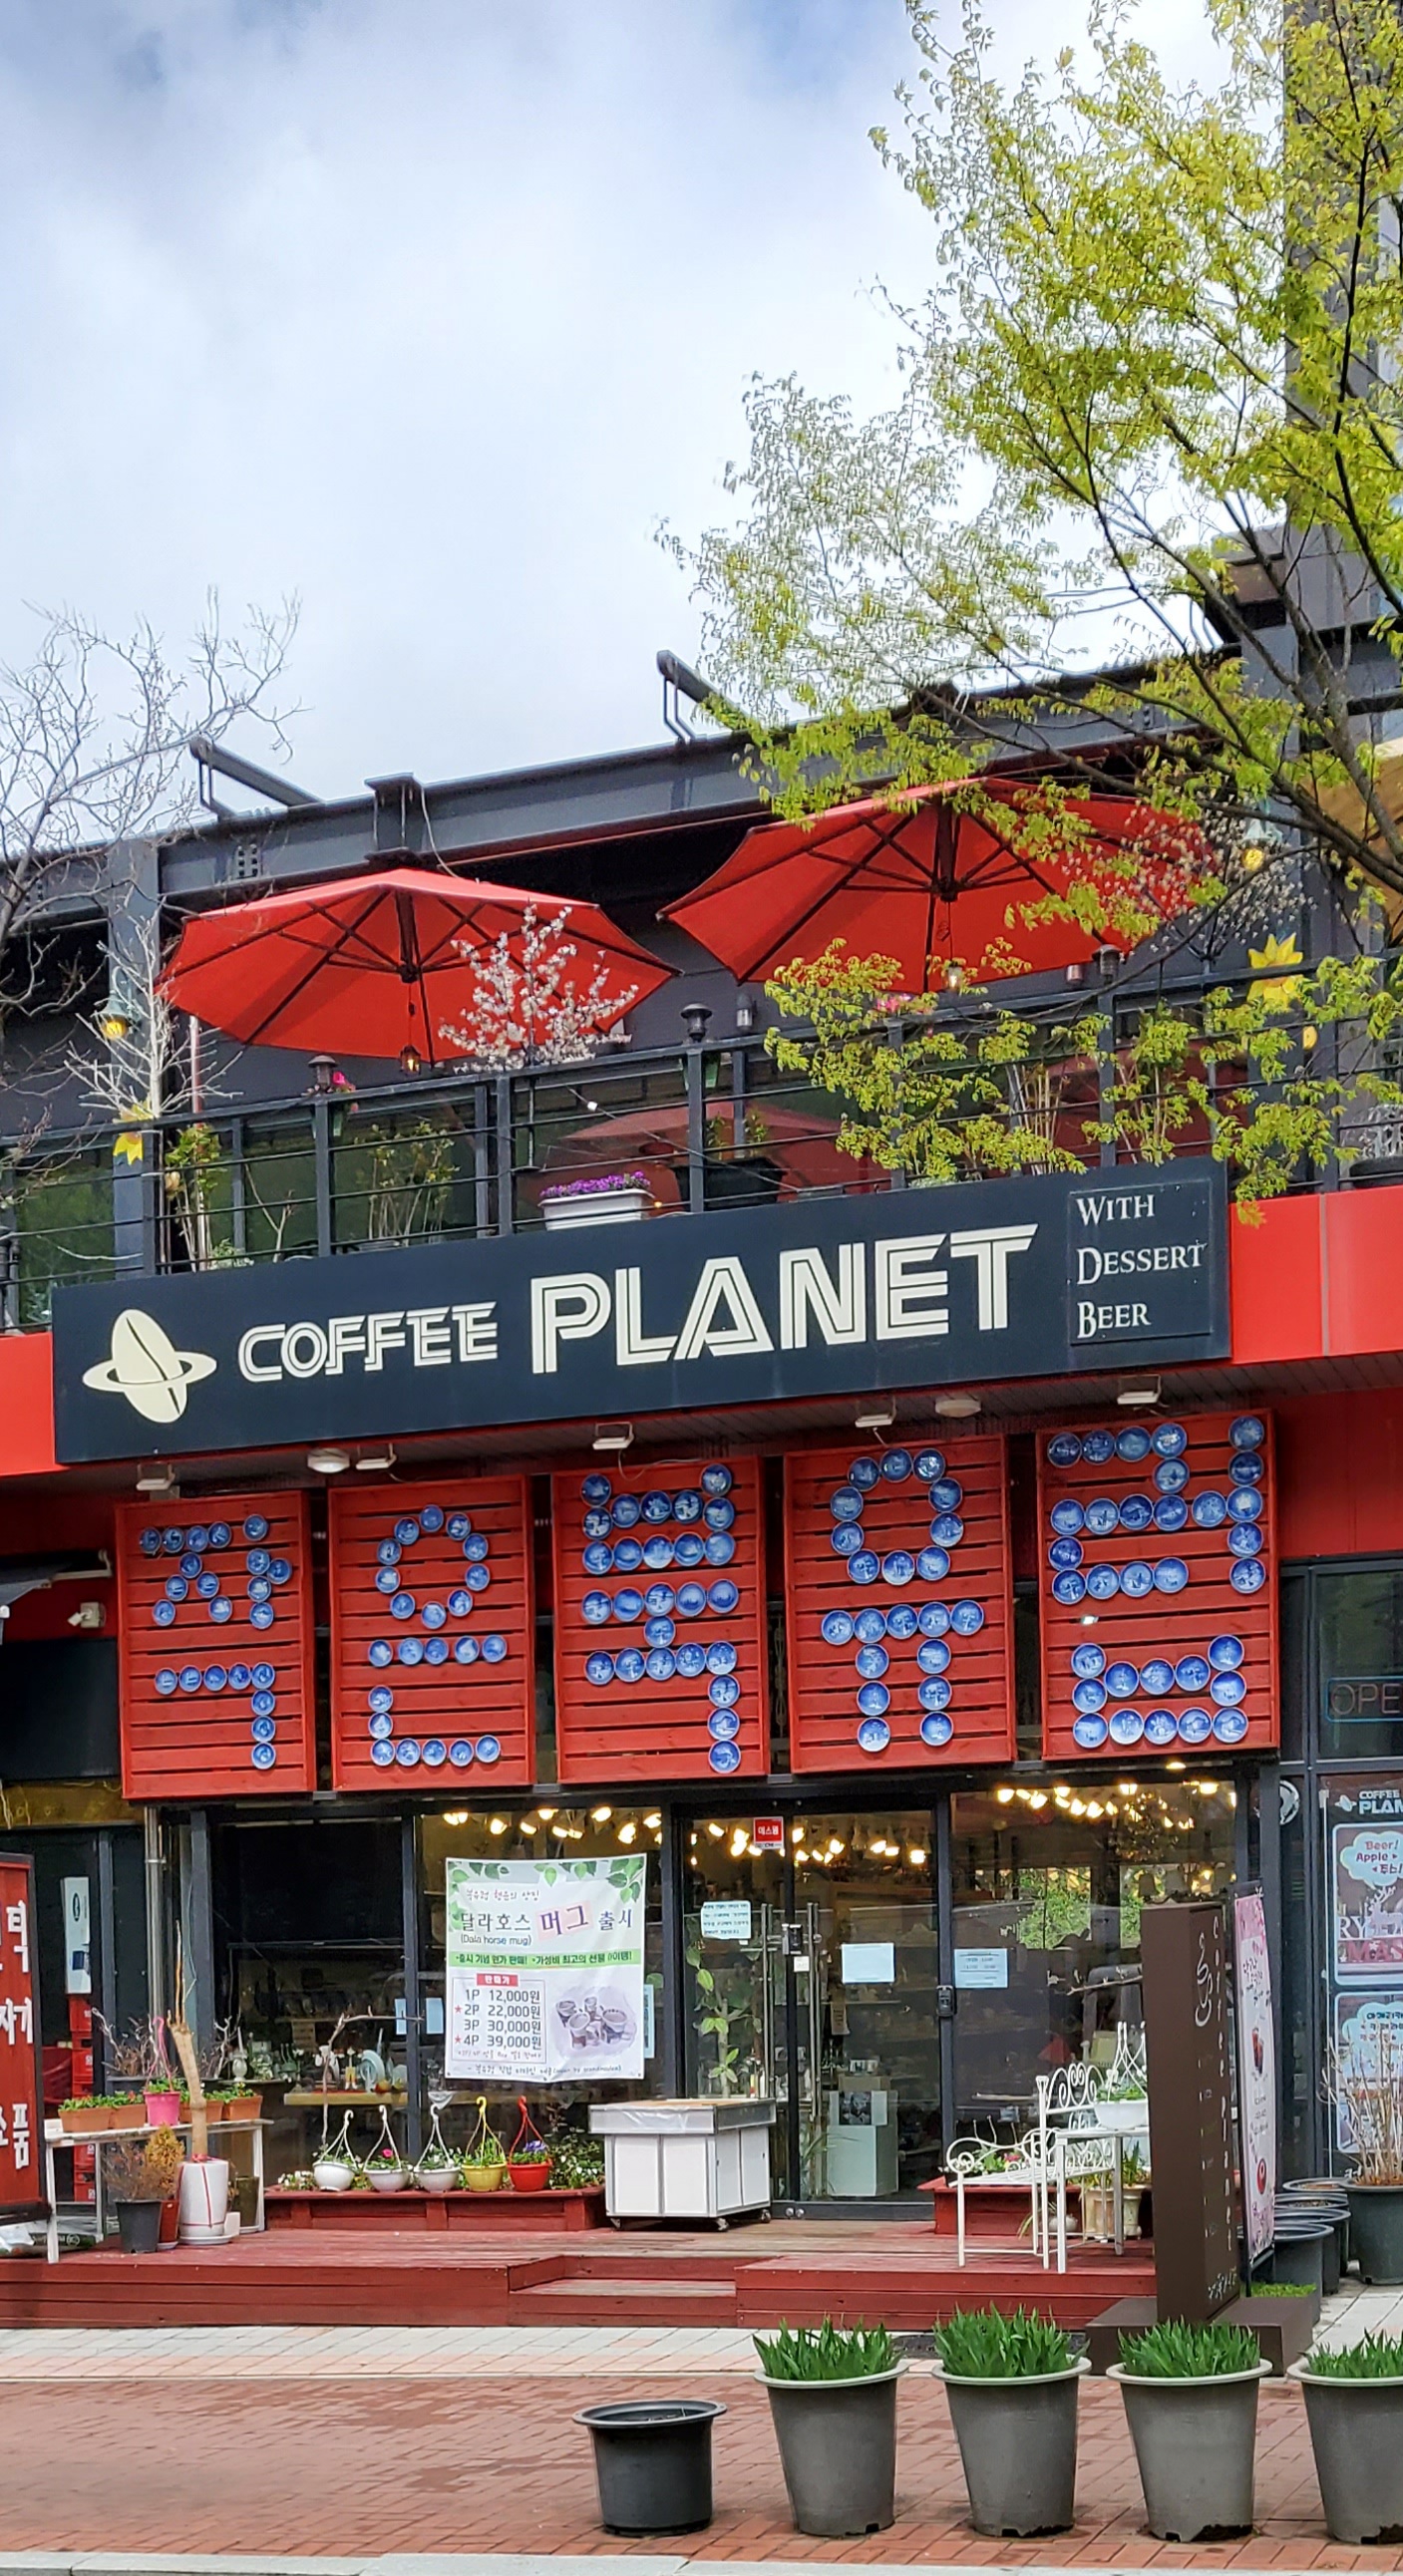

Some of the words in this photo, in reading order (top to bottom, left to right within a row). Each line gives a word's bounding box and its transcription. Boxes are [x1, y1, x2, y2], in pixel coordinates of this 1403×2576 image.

[238, 1301, 499, 1383] COFFEE
[530, 1223, 1039, 1375] PLANET
[1359, 1789, 1400, 1799] COFFEE
[1365, 1839, 1399, 1850] Beer!
[1356, 1852, 1388, 1863] Apple
[461, 1912, 530, 1932] 달라호스
[539, 1905, 588, 1935] 머그
[598, 1908, 632, 1931] 출시
[484, 1935, 507, 1945] horse
[510, 1934, 531, 1946] mug)
[466, 1989, 481, 2000] 1P
[489, 1989, 539, 2004] 12,000원
[464, 2004, 480, 2016] 2P
[488, 2005, 540, 2020] 22,000원
[464, 2020, 480, 2031] 3P
[487, 2020, 541, 2035] 30,000원
[463, 2035, 480, 2046] 4P
[487, 2035, 541, 2051] 39,000원
